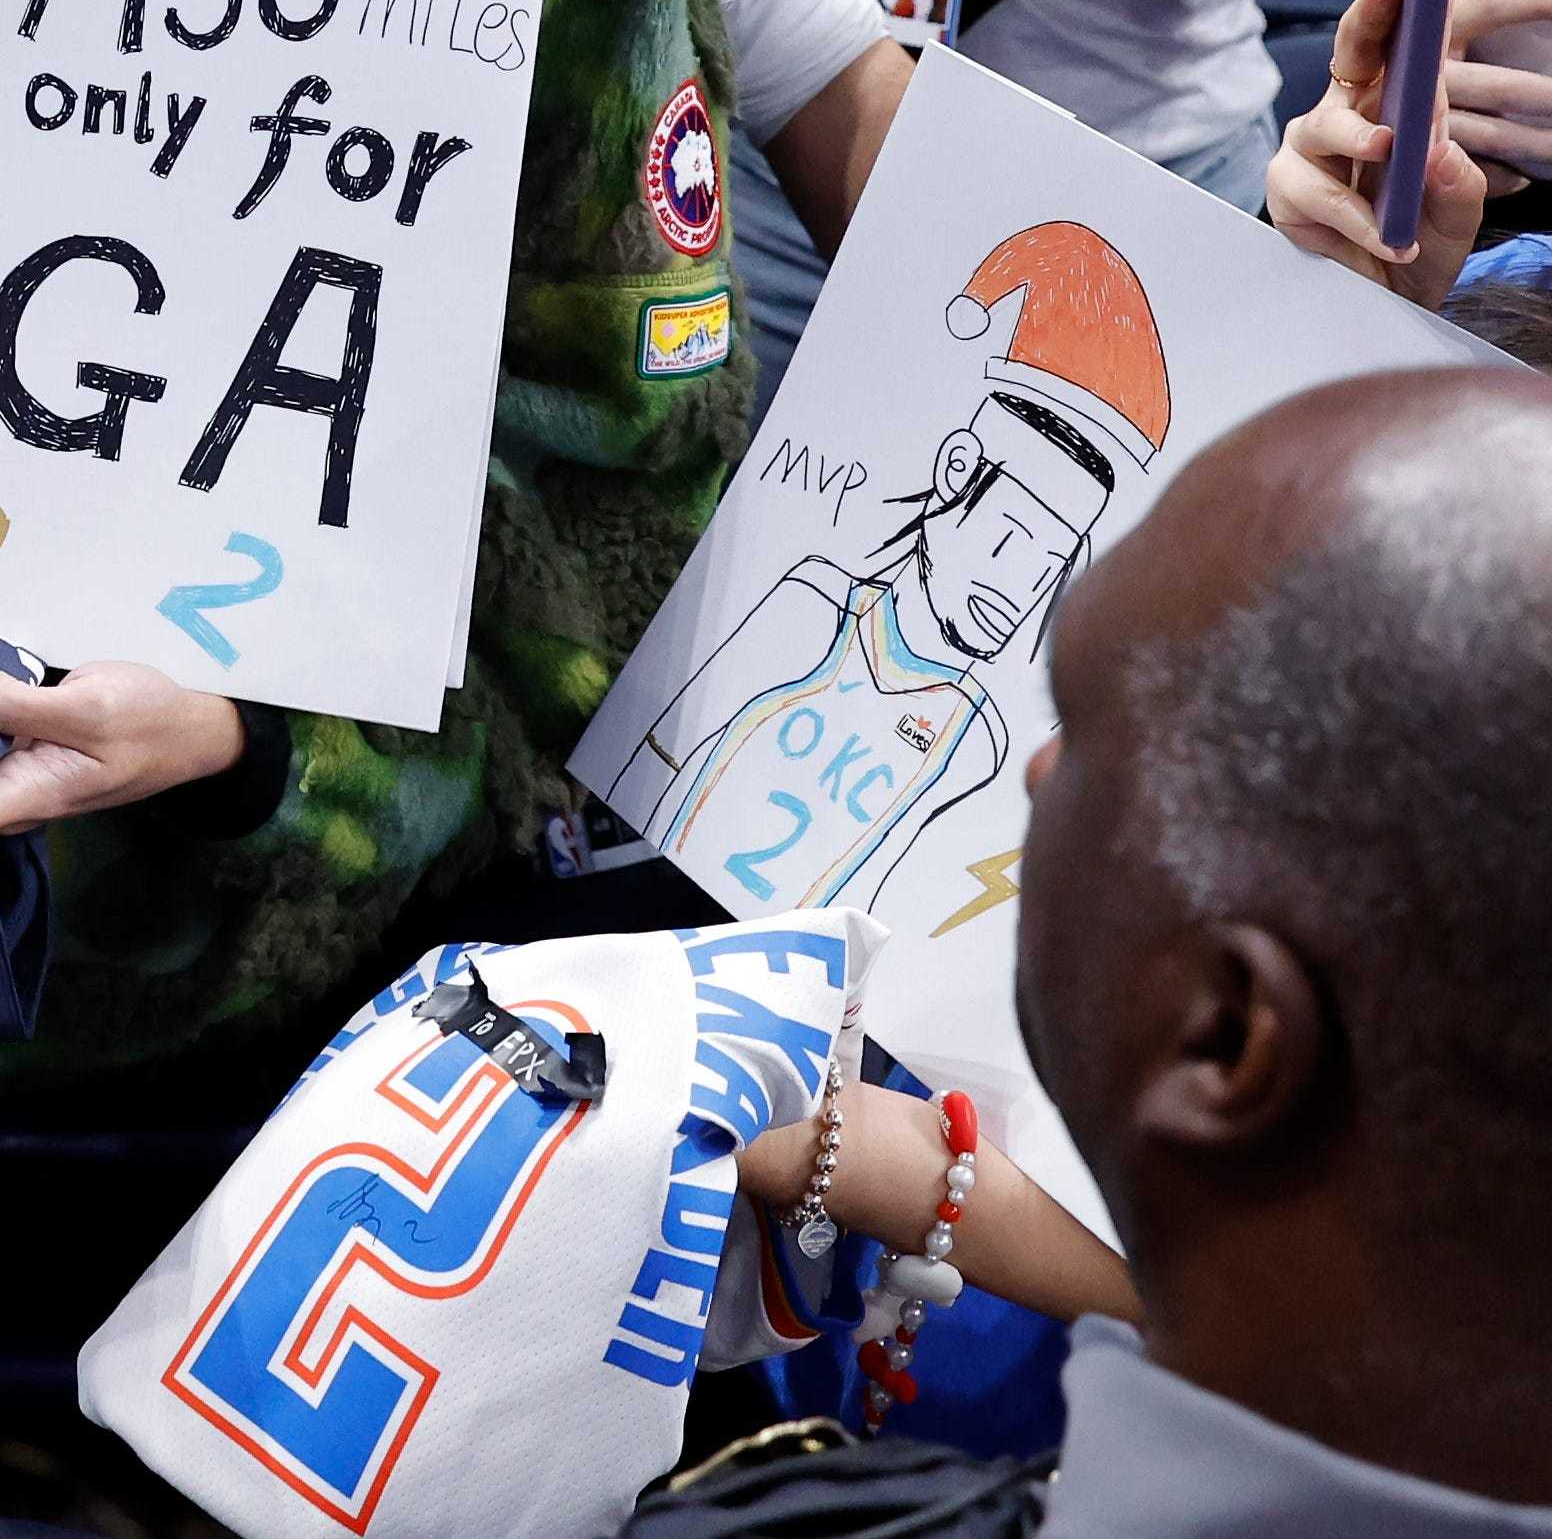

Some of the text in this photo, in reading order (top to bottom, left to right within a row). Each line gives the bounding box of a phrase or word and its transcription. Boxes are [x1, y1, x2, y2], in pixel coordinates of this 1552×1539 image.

[25, 71, 207, 179] only
[233, 74, 473, 226] for
[657, 207, 688, 242] ARCTIC
[759, 438, 868, 527] MVP
[155, 531, 284, 672] 2
[777, 707, 895, 824] OKC
[725, 789, 813, 902] 2
[161, 999, 594, 1537] 2
